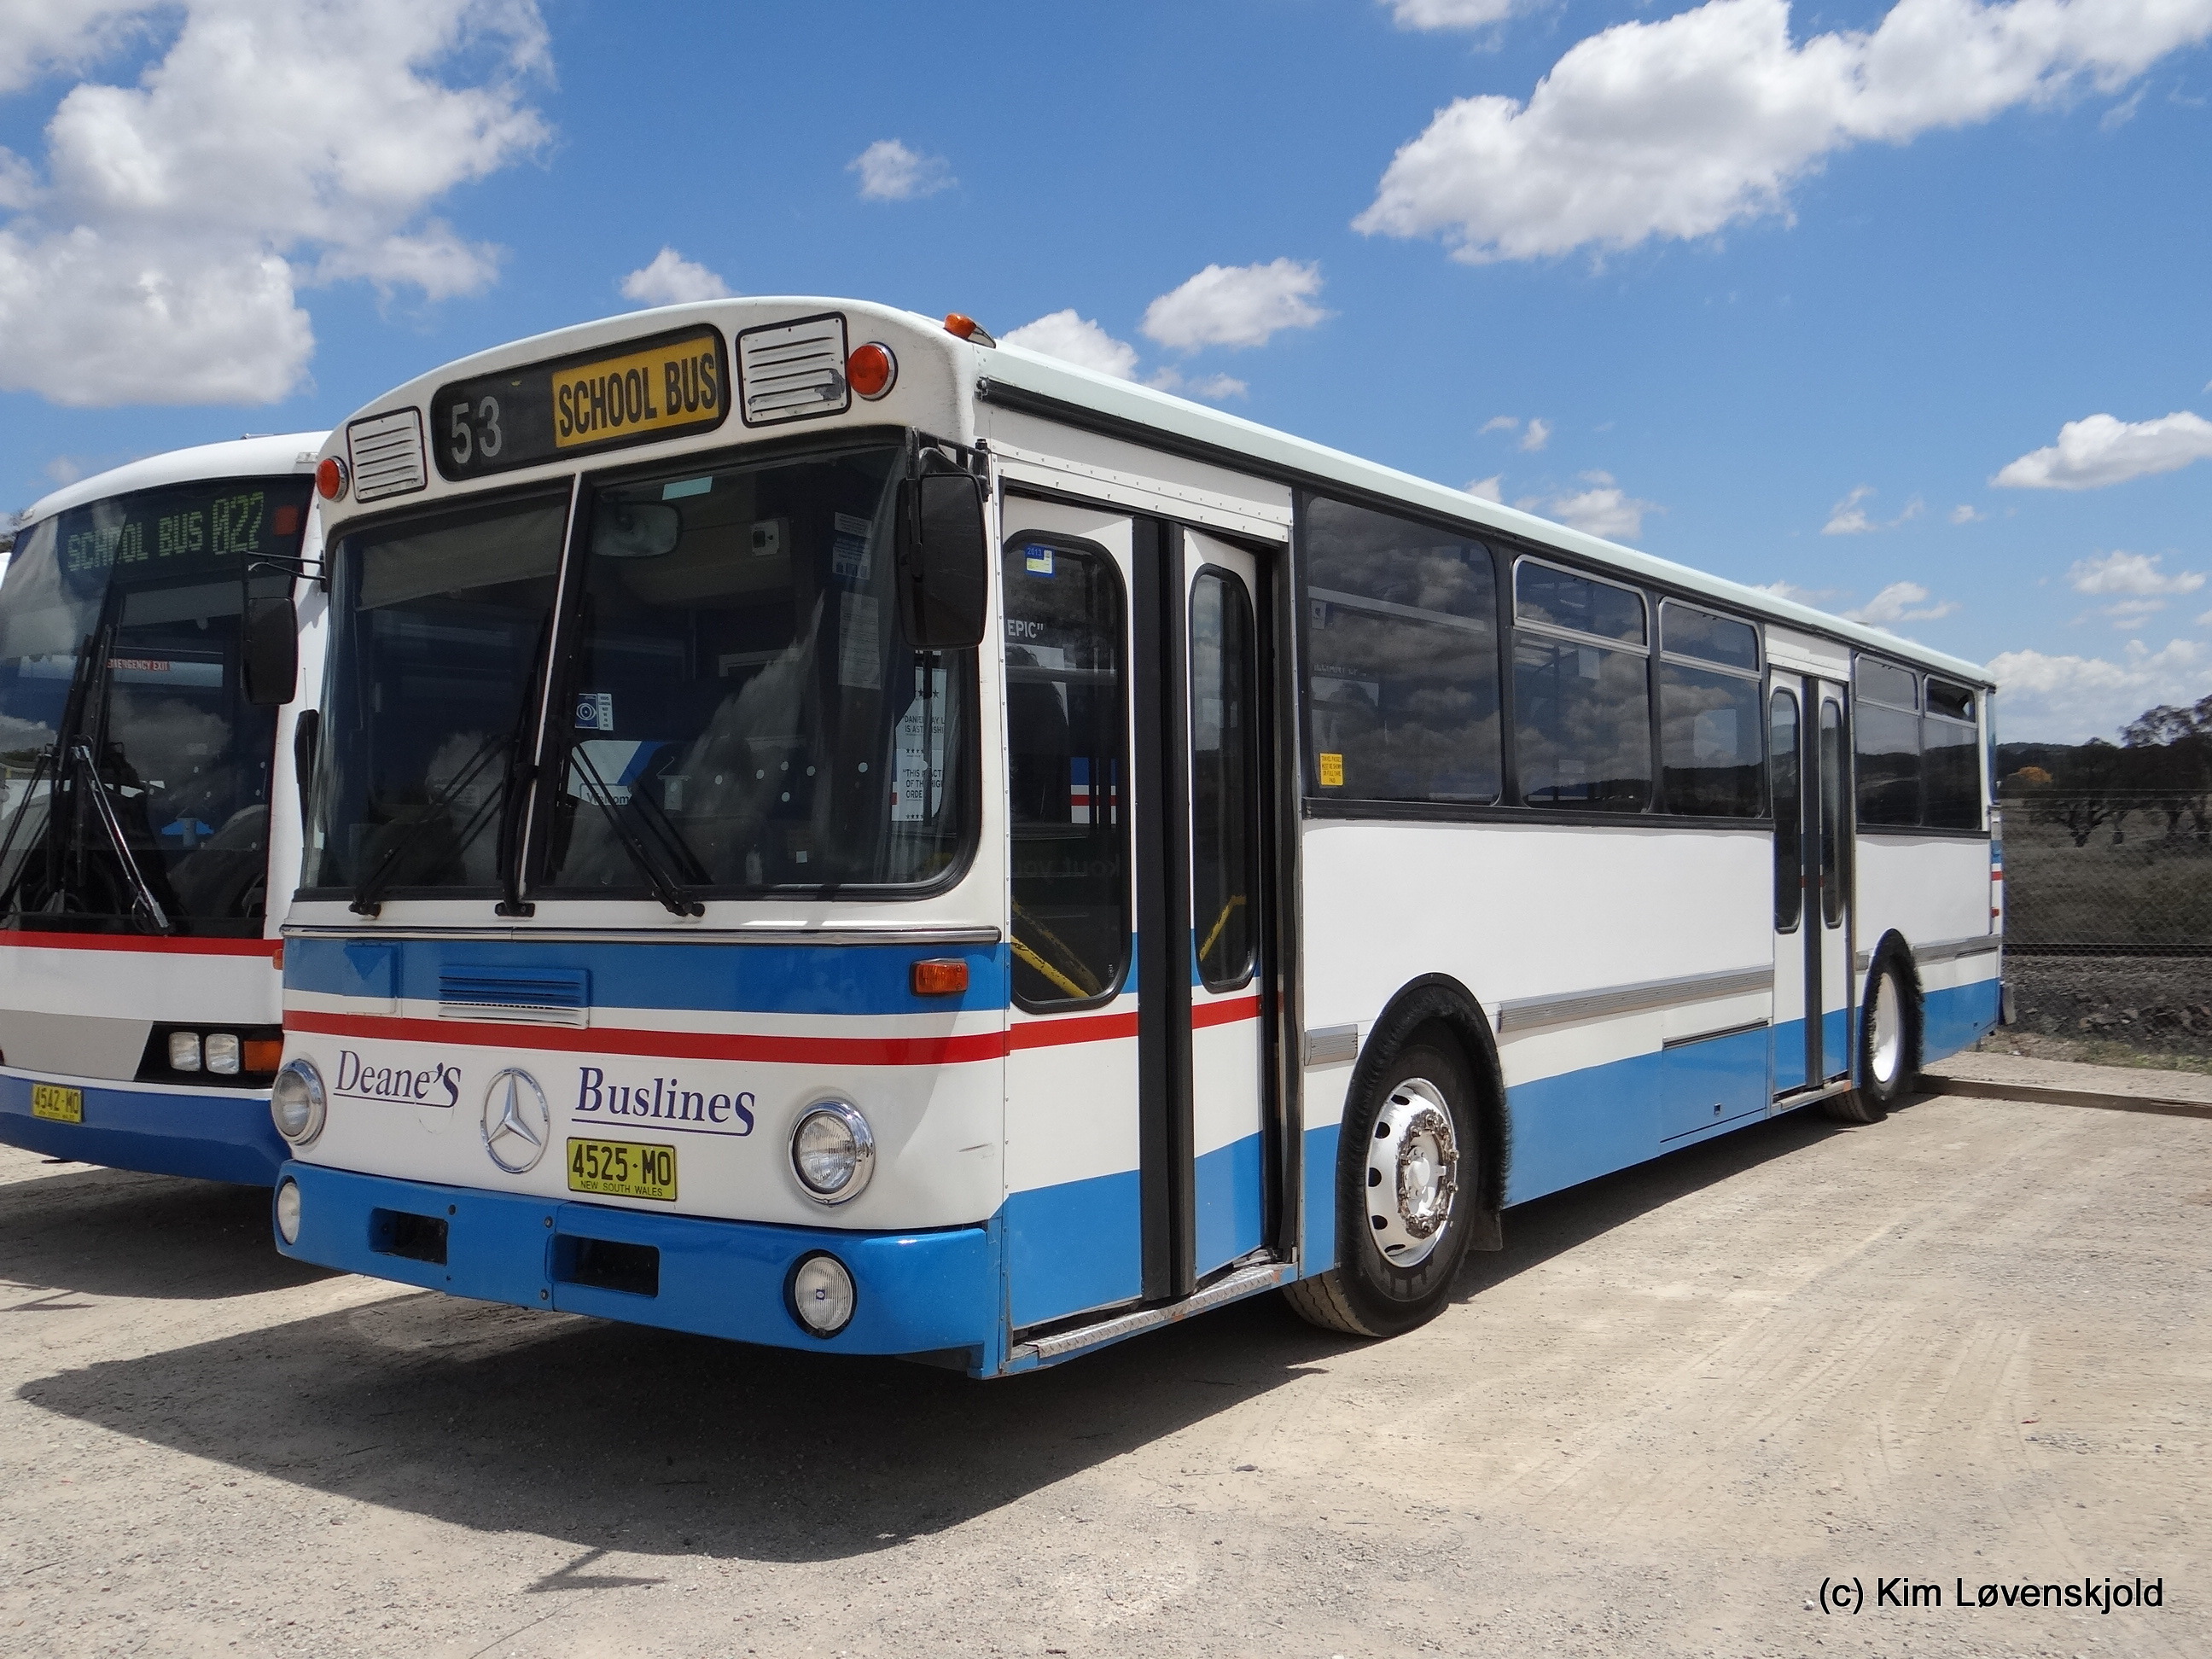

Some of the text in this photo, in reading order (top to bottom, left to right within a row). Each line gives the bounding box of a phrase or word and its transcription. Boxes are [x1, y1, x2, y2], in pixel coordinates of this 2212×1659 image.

[451, 352, 717, 465] 53 SCHOOL BUS
[67, 521, 149, 572] SCHOOL
[160, 511, 204, 557] BUS
[153, 660, 169, 671] EXIT
[580, 1180, 663, 1196] NEW SOUTH WALES
